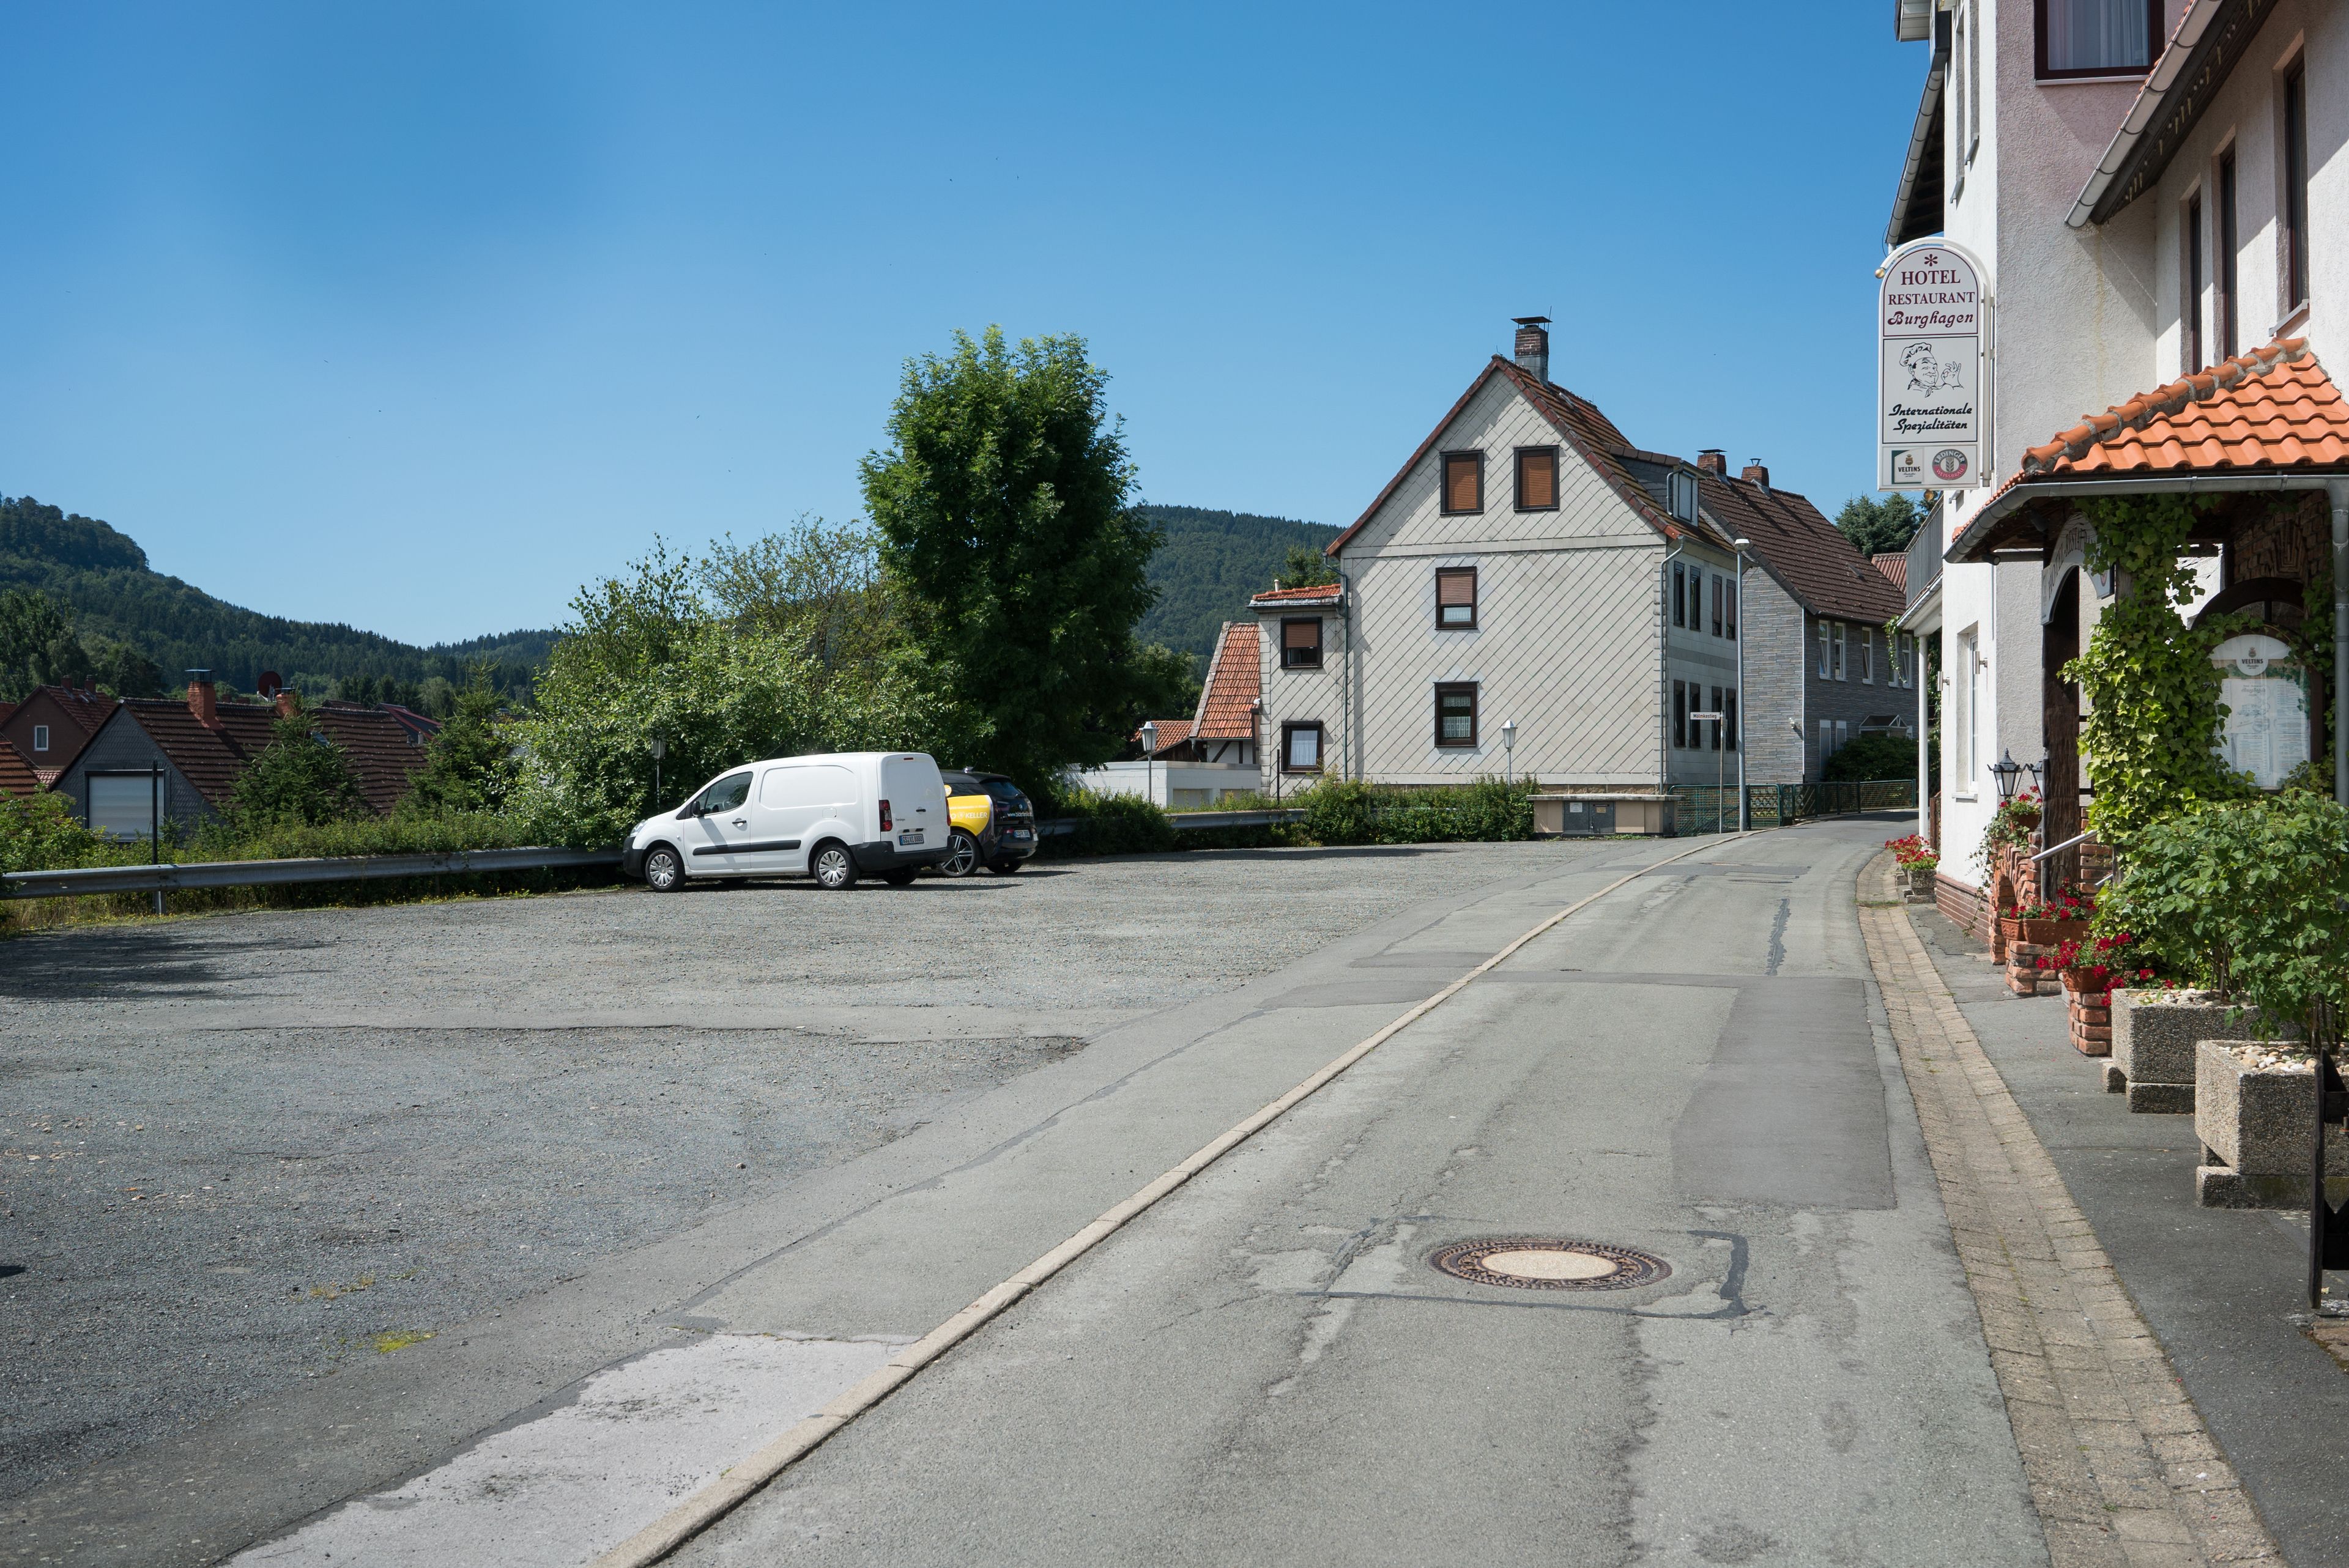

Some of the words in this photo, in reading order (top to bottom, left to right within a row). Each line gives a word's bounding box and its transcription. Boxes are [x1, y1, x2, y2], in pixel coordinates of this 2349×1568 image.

[1901, 270, 1961, 286] HOTEL
[1888, 292, 1975, 305] RESTAURANT
[1887, 311, 1973, 328] Burghagen
[1888, 402, 1972, 416] Internationale
[1893, 418, 1967, 434] Spezialitäten
[1934, 450, 1965, 463] ERDINGER
